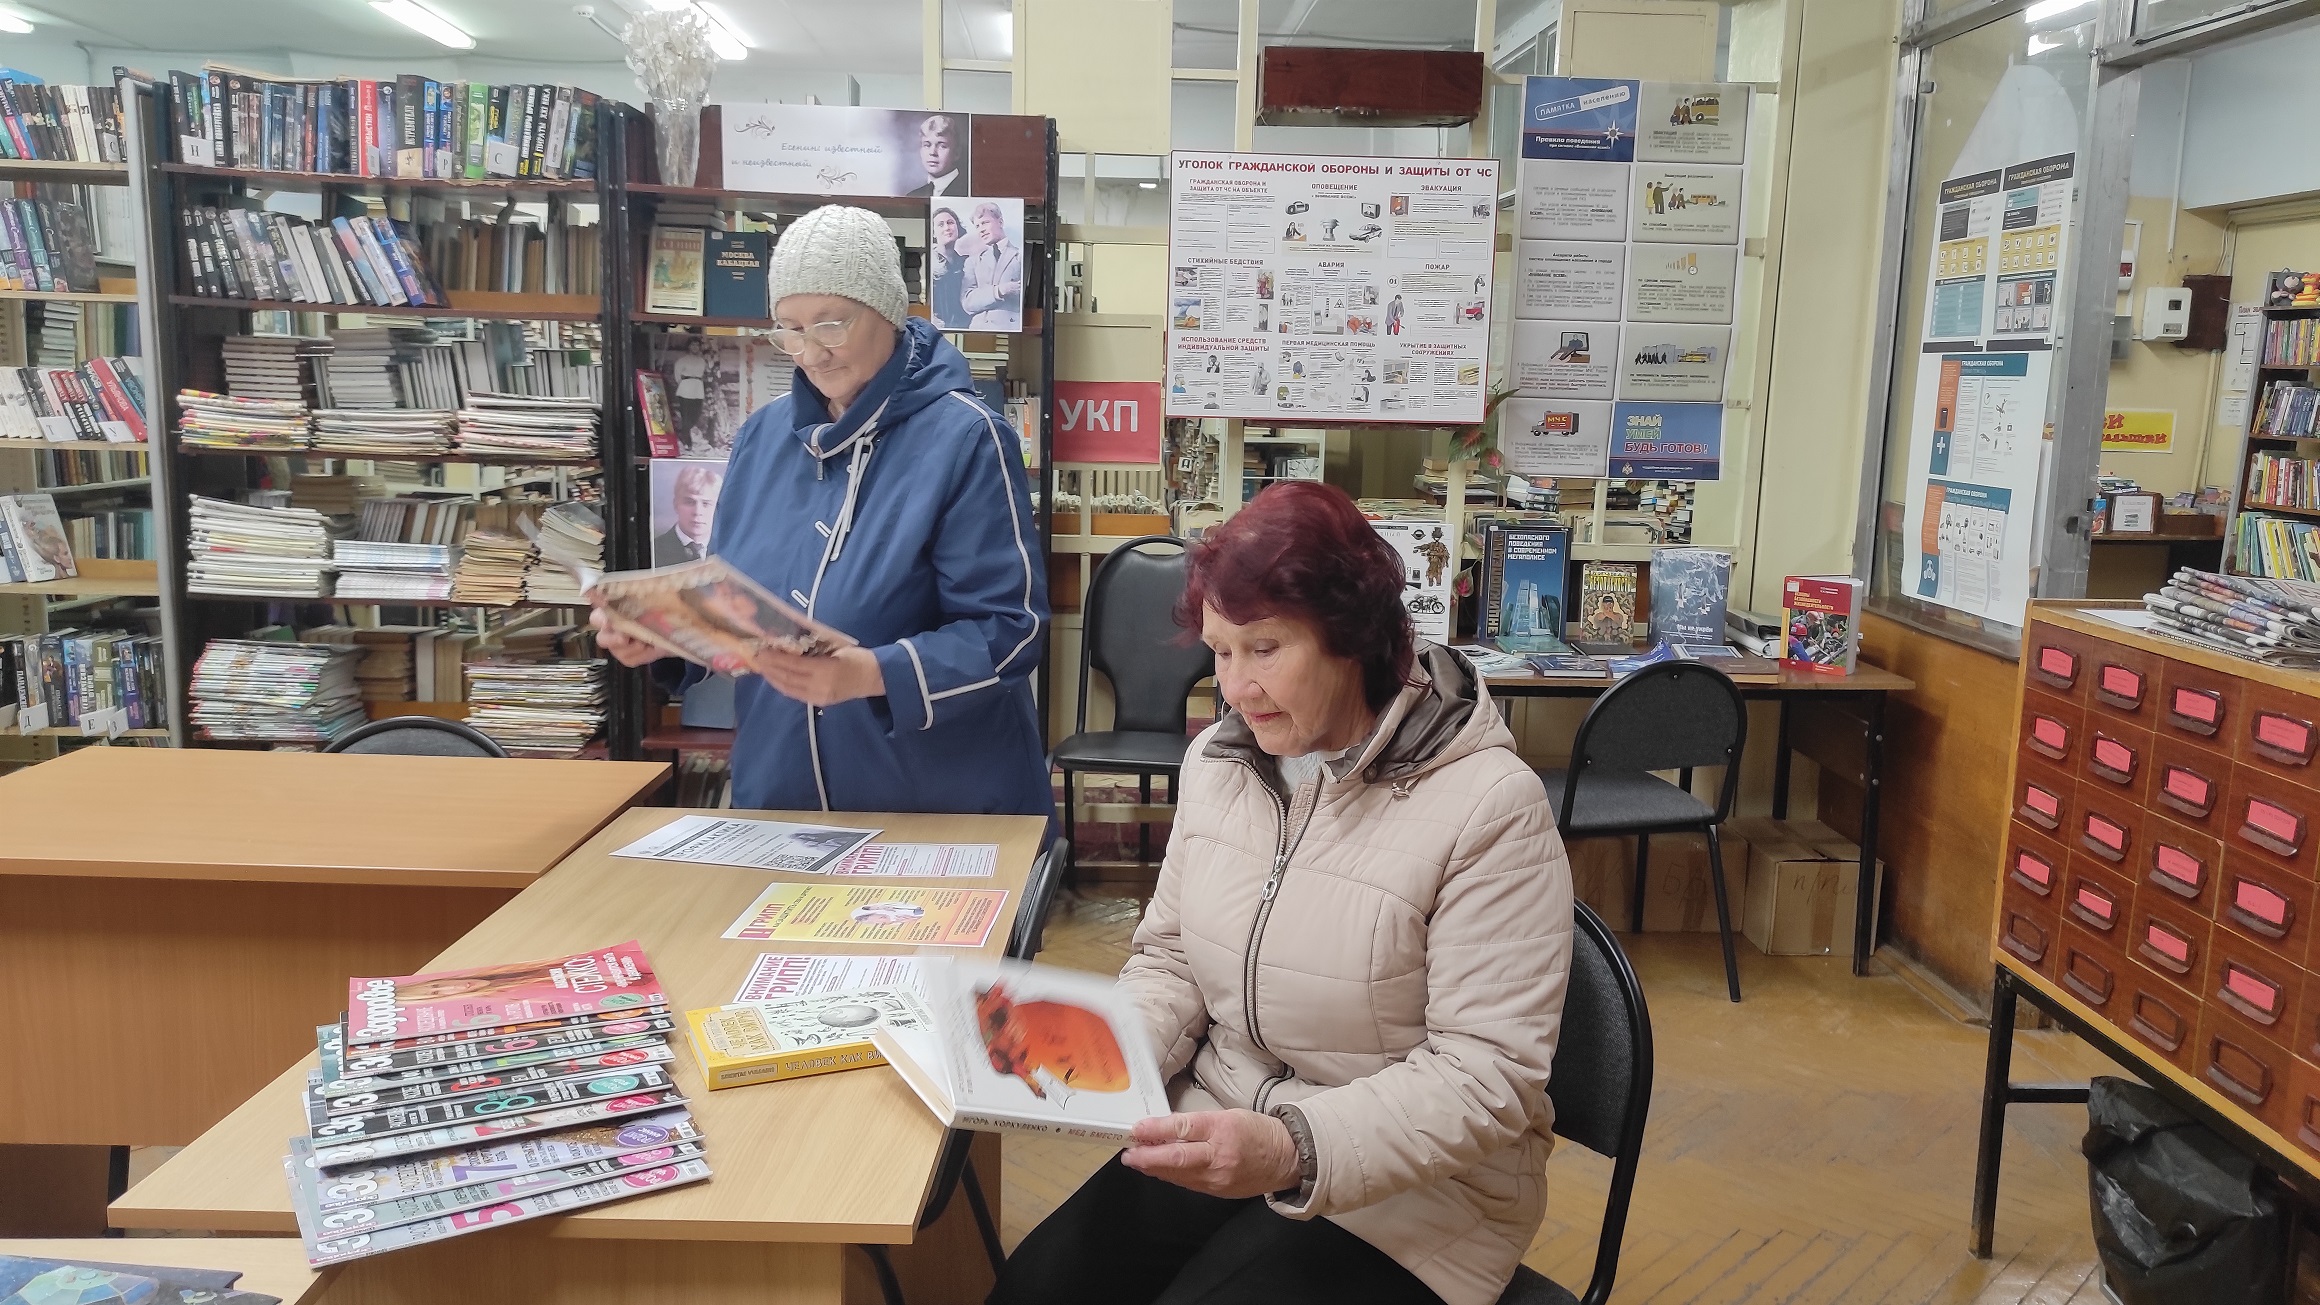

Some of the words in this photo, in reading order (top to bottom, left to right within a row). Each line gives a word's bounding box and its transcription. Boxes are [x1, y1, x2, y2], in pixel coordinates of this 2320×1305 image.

[1583, 91, 1626, 106] населению
[534, 122, 546, 151] ПИРАТЫ
[1536, 136, 1564, 144] Правила
[190, 142, 200, 157] Н
[824, 143, 883, 154] известный
[494, 153, 502, 164] С
[731, 159, 740, 167] и
[742, 157, 813, 169] неизвестный
[1178, 159, 1223, 170] УГОЛОК
[1229, 161, 1316, 173] ГРАЖДАНСКОЙ
[1322, 164, 1379, 175] ОБОРОНЫ
[1385, 166, 1393, 175] И
[1399, 166, 1450, 177] ЗАЩИТЫ
[1456, 168, 1471, 177] ОТ
[1477, 168, 1493, 177] ЧС
[2008, 168, 2042, 181] ГРАЖДАНСКАЯ
[2043, 162, 2069, 174] ОБОРОНА
[1311, 183, 1358, 191] ОПОВЕЩЕНИЕ
[1944, 182, 1974, 195] ГРАЖДАНСКАЯ
[1976, 178, 1997, 189] ОБОРОНА
[716, 260, 760, 268] КАБАЦКАЯ
[1318, 261, 1345, 269] АВАРИЯ
[1178, 343, 1239, 351] ИНДИВИДУАЛЬНОЙ
[1306, 340, 1352, 348] МЕДИЦИНСКАЯ
[1400, 342, 1425, 350] УКРЫТИЕ
[107, 380, 129, 411] УЛЬЯНОВА
[1059, 399, 1138, 432] УКП
[1626, 414, 1663, 427] ЗНАЙ
[46, 425, 54, 435] Т
[1626, 428, 1662, 440] УМЕЙ
[1624, 442, 1657, 453] БУДЬ
[1946, 487, 1971, 496] ГРАЖДАНСКАЯ
[1971, 491, 1987, 499] ОБОРОНА
[1488, 532, 1504, 637] ЭНЦИКЛОПЕДИЯ
[88, 719, 95, 730] Е
[669, 822, 743, 857] ПРОФИЛАКТИКА
[842, 845, 884, 874] ГРИПП!
[747, 903, 786, 927] ГРИПП
[561, 955, 609, 994] СТЕЖКО:
[743, 956, 785, 999] ВНИМАНИЕ
[763, 956, 812, 999] ГРИПП!
[355, 976, 408, 1038] Здоровье
[450, 1012, 502, 1028] 6
[840, 1051, 862, 1064] КАК
[473, 1095, 536, 1115] 8
[961, 1115, 989, 1125] ИГОРЬ
[1090, 1130, 1123, 1141] ВМЕСТО
[451, 1155, 518, 1182] 7
[452, 1201, 516, 1230] 5
